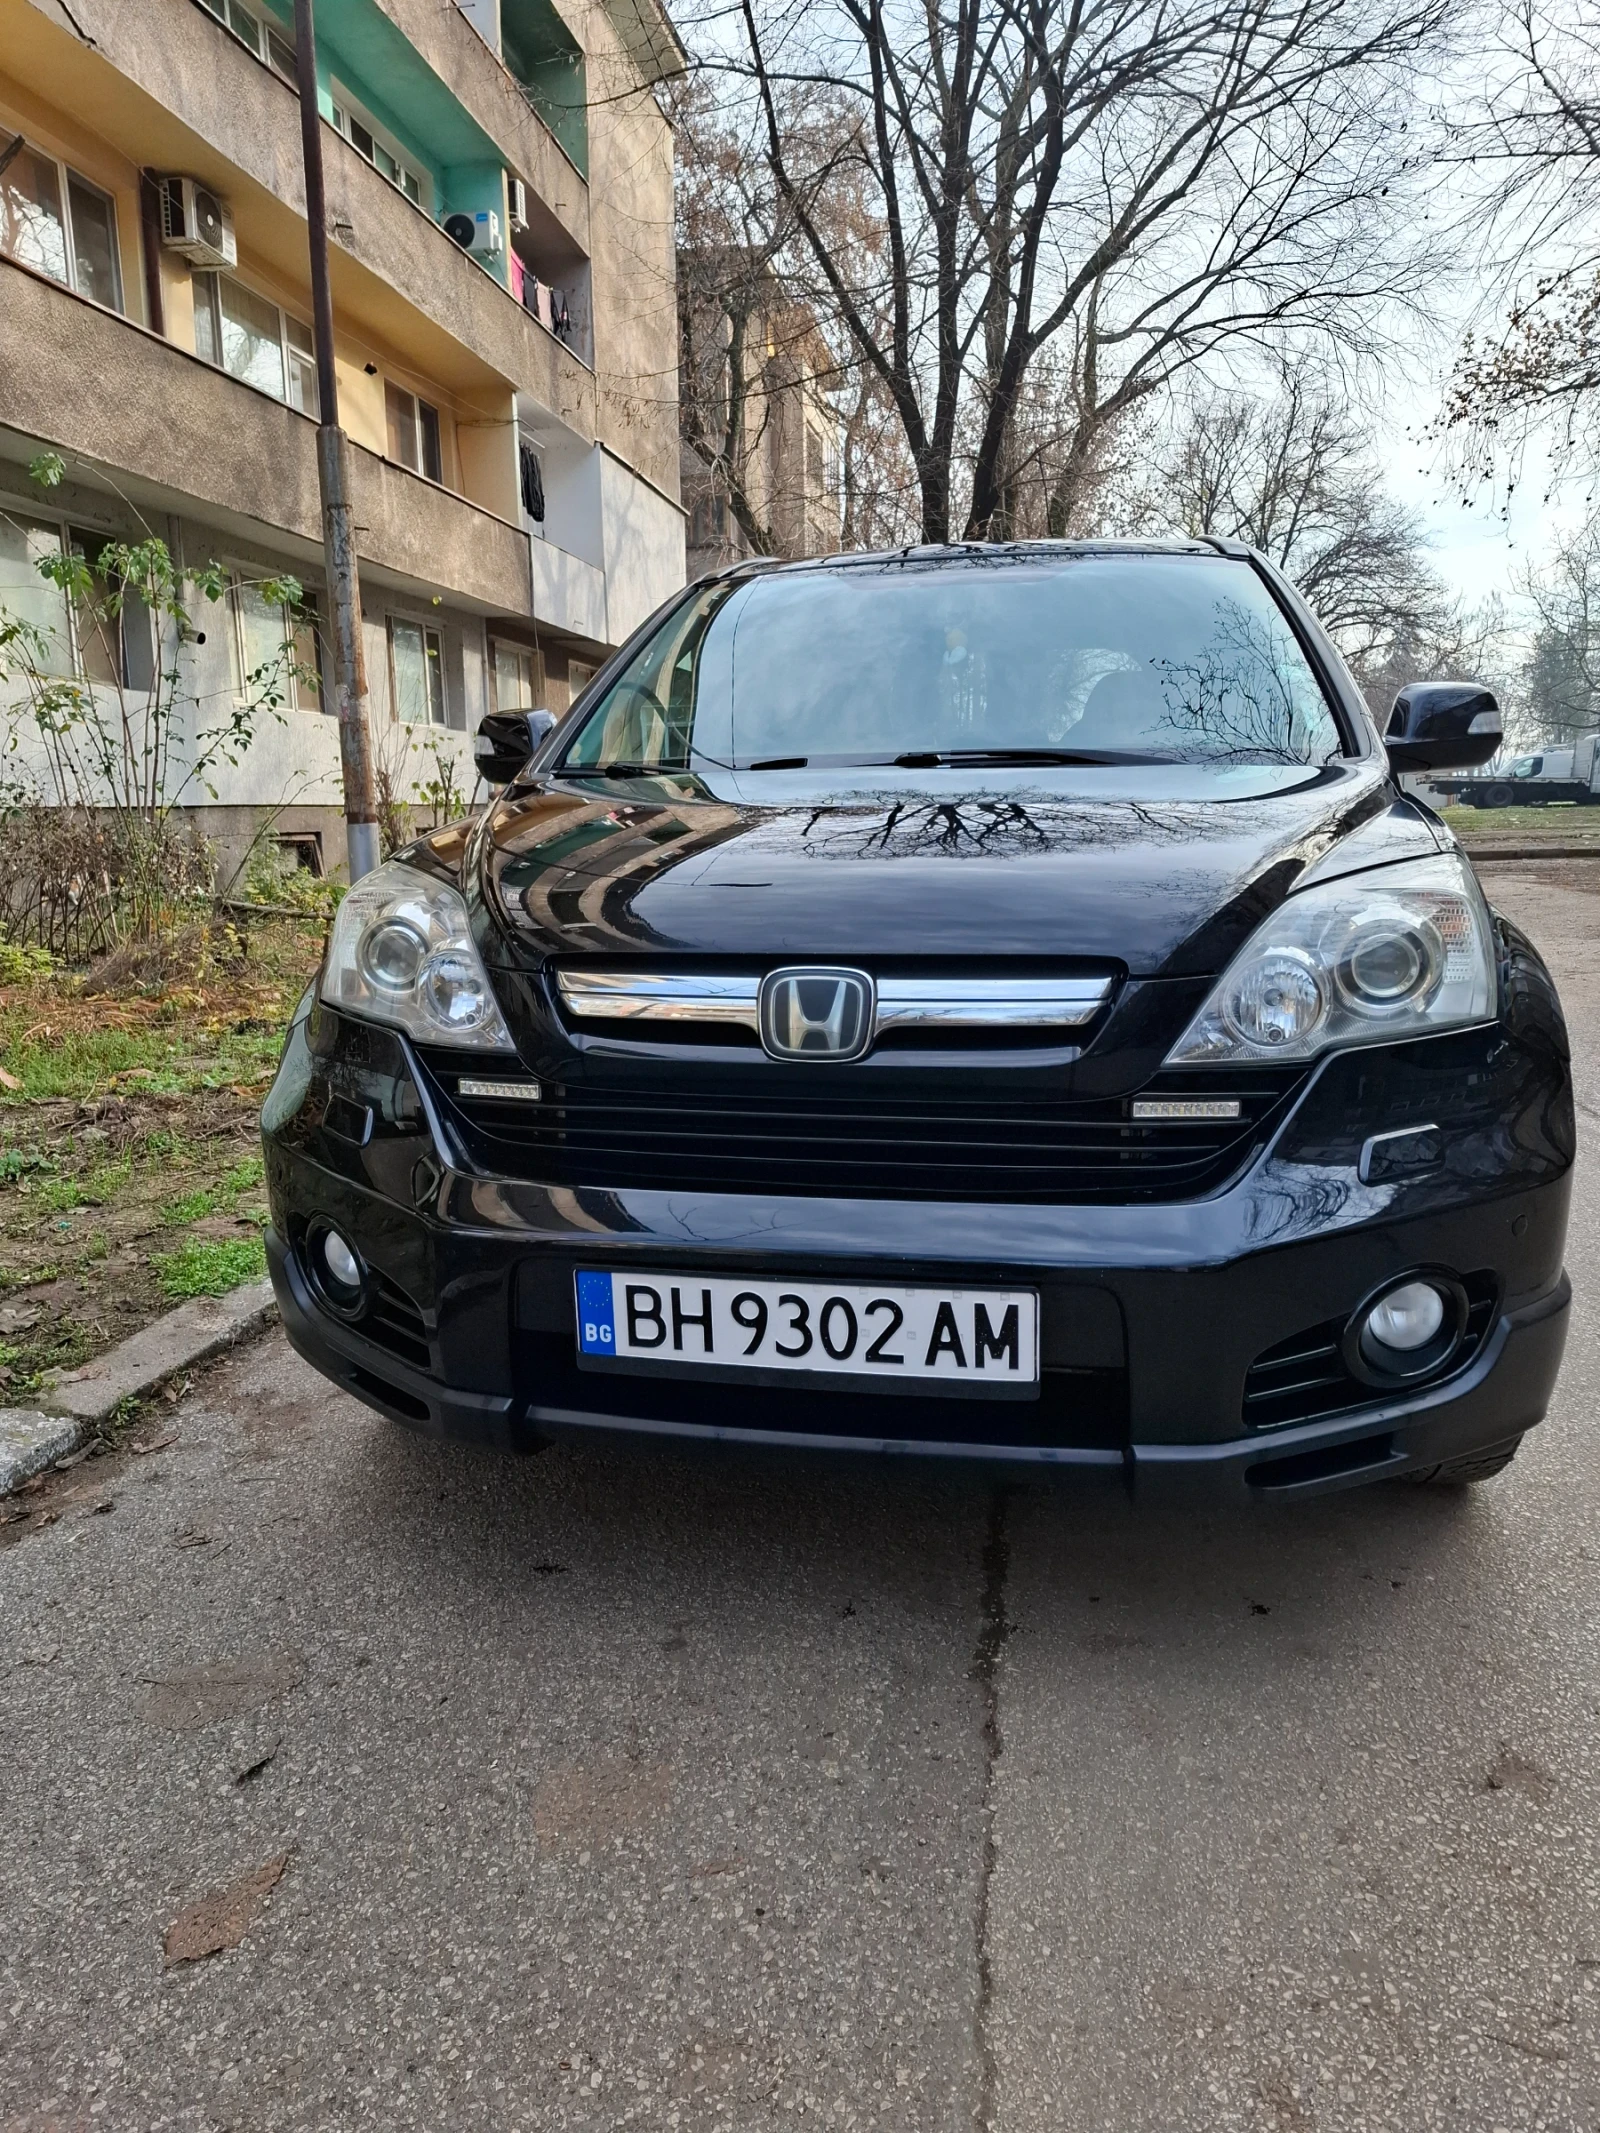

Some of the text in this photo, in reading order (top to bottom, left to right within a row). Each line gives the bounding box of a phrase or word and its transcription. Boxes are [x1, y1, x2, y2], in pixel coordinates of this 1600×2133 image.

[585, 1323, 612, 1343] BG
[625, 1284, 1019, 1370] BH 9302 AM
